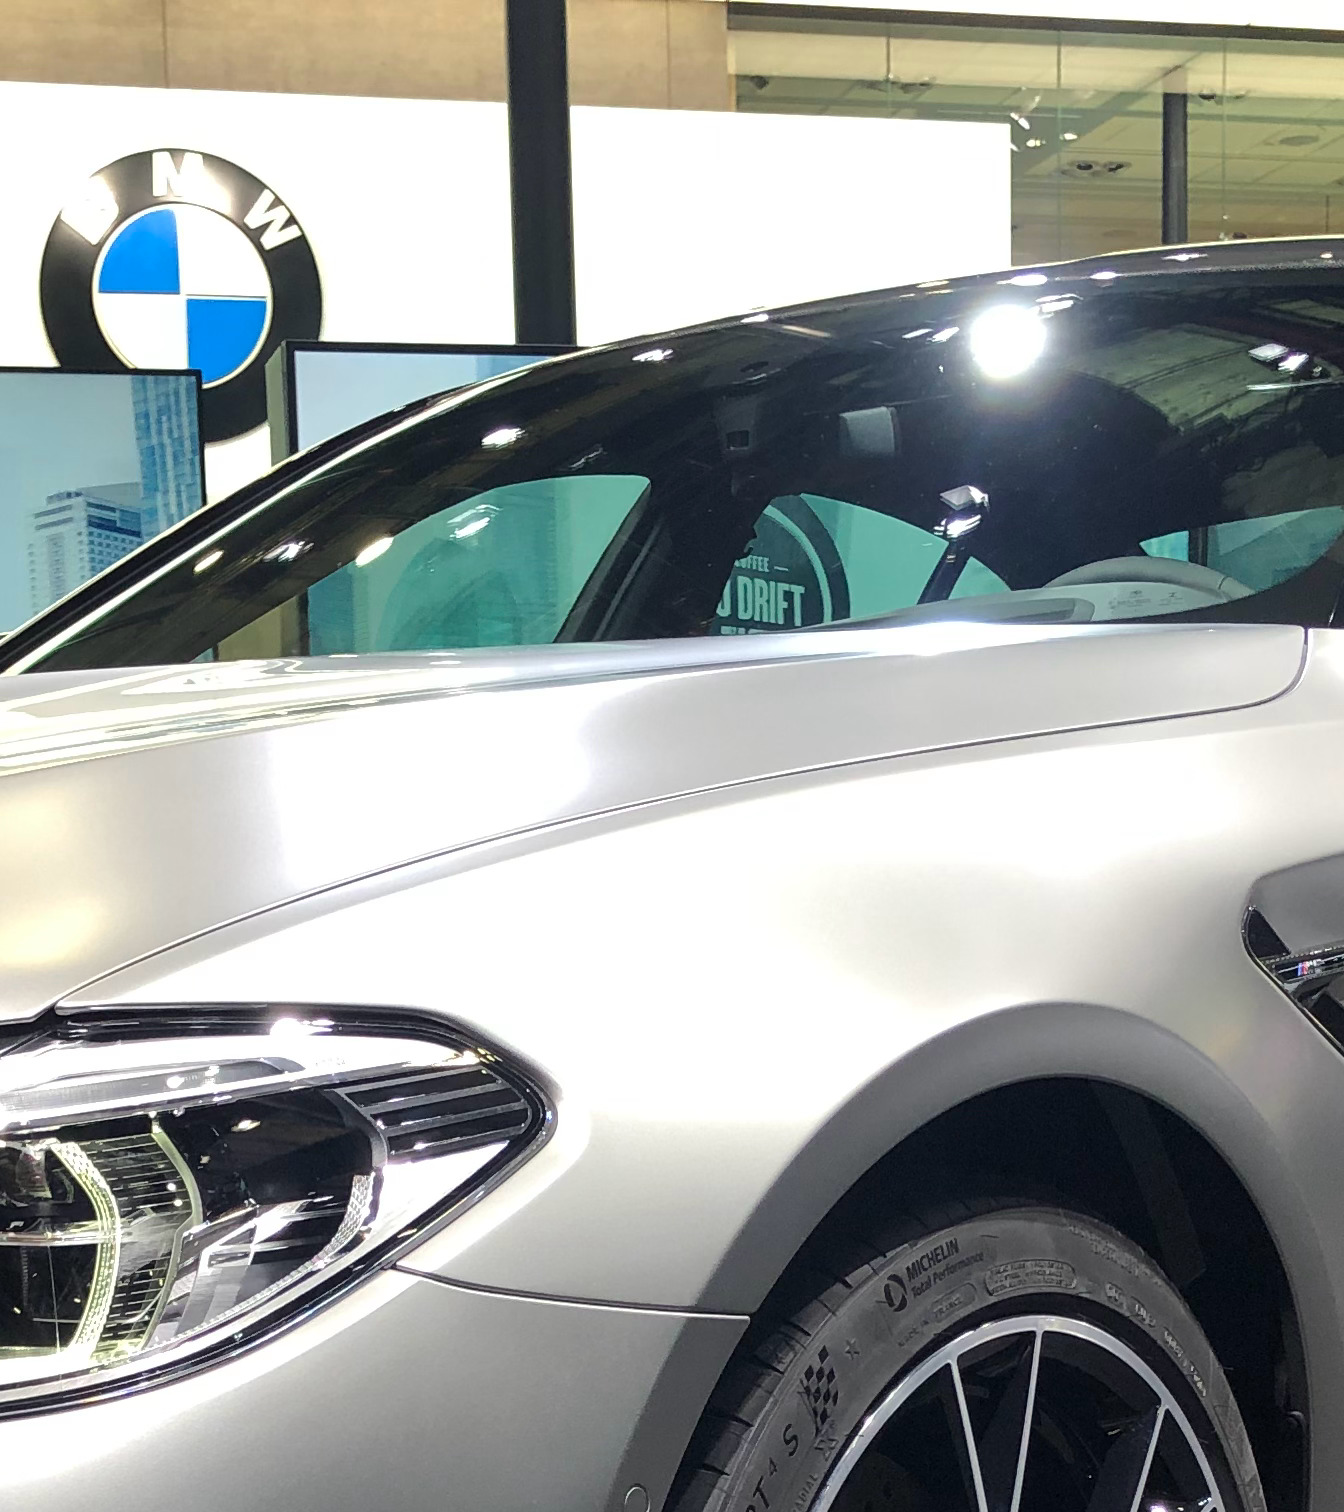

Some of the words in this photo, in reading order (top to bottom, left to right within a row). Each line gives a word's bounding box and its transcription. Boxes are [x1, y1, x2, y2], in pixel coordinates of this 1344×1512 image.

[736, 575, 806, 627] DRIFT
[905, 1237, 961, 1282] MICHELIN
[910, 1273, 933, 1299] Total
[932, 1251, 985, 1285] Performance
[768, 1456, 778, 1478] 4
[782, 1423, 799, 1457] S
